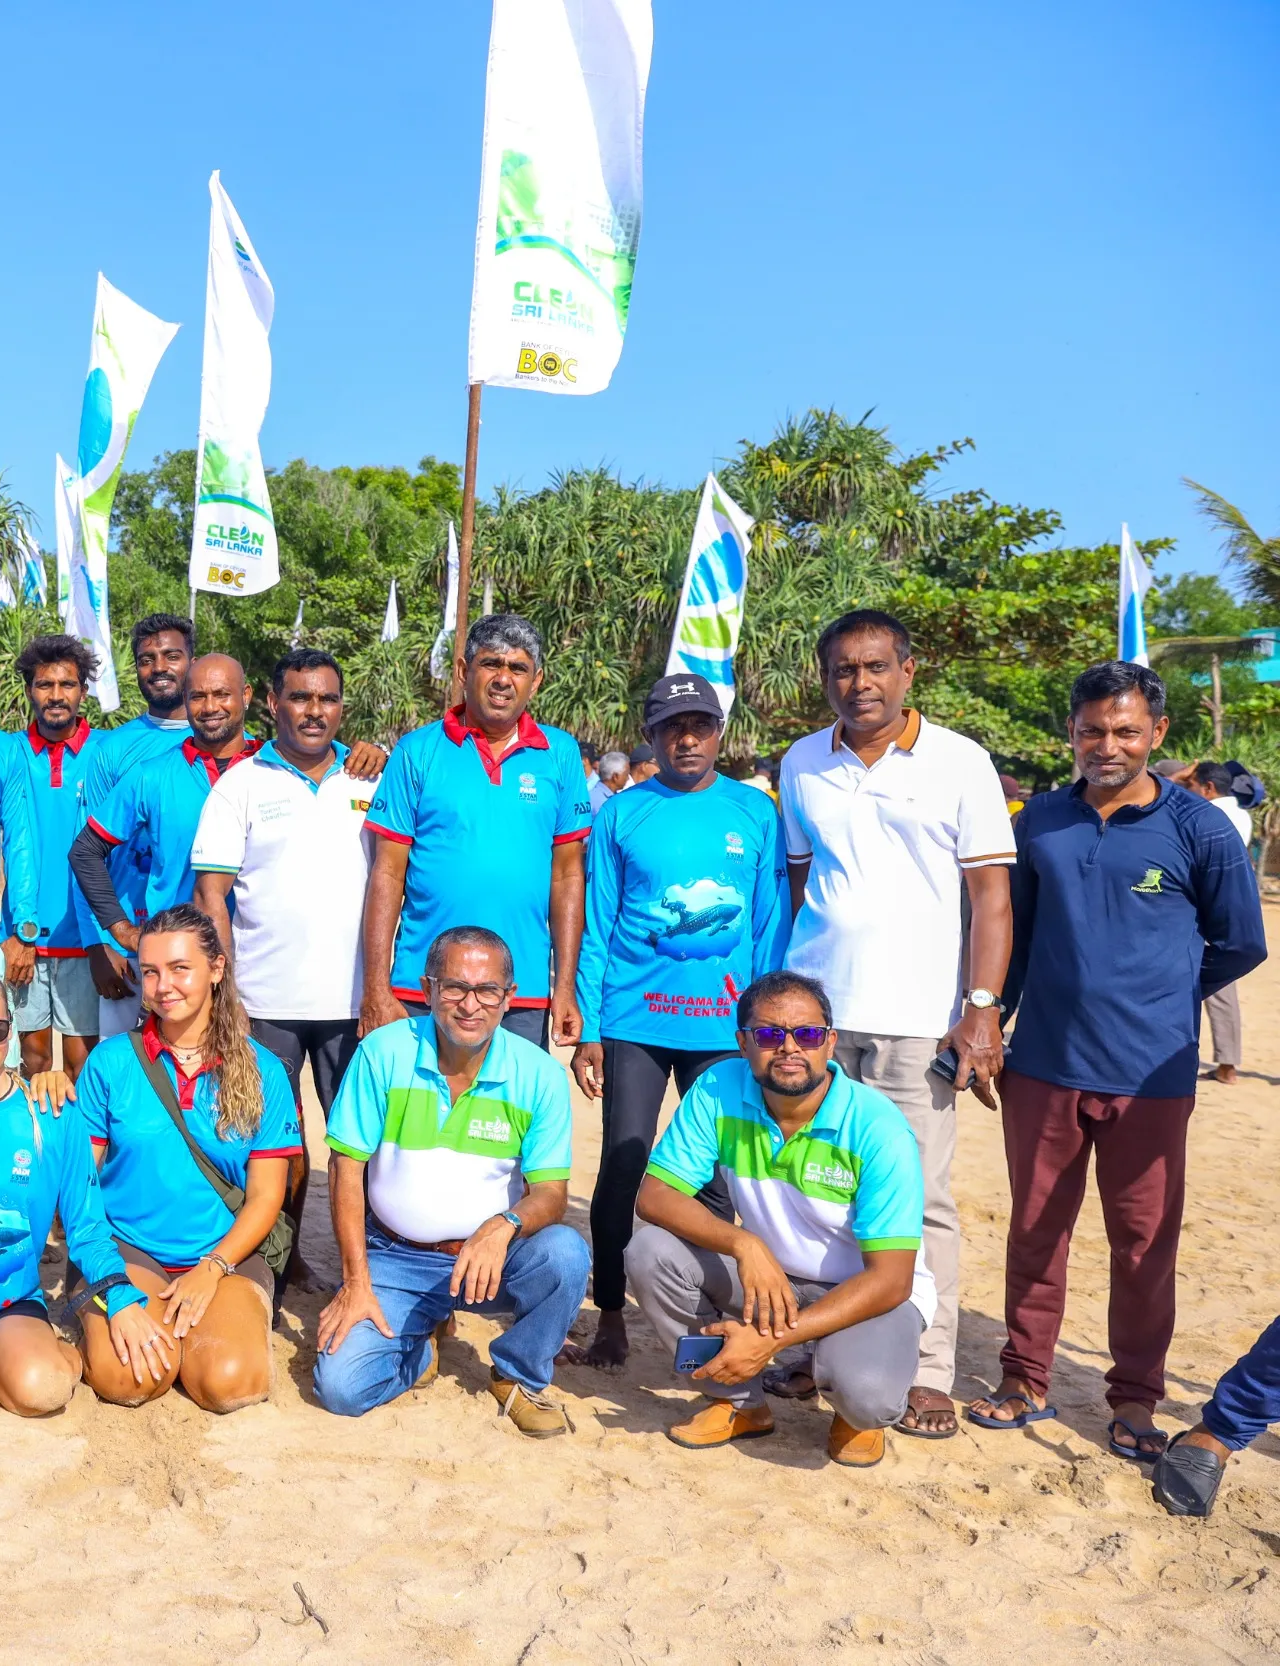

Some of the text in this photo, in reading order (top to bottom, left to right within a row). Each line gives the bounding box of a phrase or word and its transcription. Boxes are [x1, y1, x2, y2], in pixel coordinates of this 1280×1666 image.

[511, 303, 542, 318] SRI
[521, 341, 541, 349] BANK
[543, 343, 553, 351] OF
[517, 348, 578, 383] BOC
[205, 538, 224, 548] SRI
[227, 542, 263, 556] LANKA
[207, 566, 246, 589] BOC
[574, 801, 592, 815] PAD
[644, 991, 713, 1006] WELIGAMA
[648, 1003, 731, 1017] DIVE CENTER
[285, 1122, 300, 1135] PA
